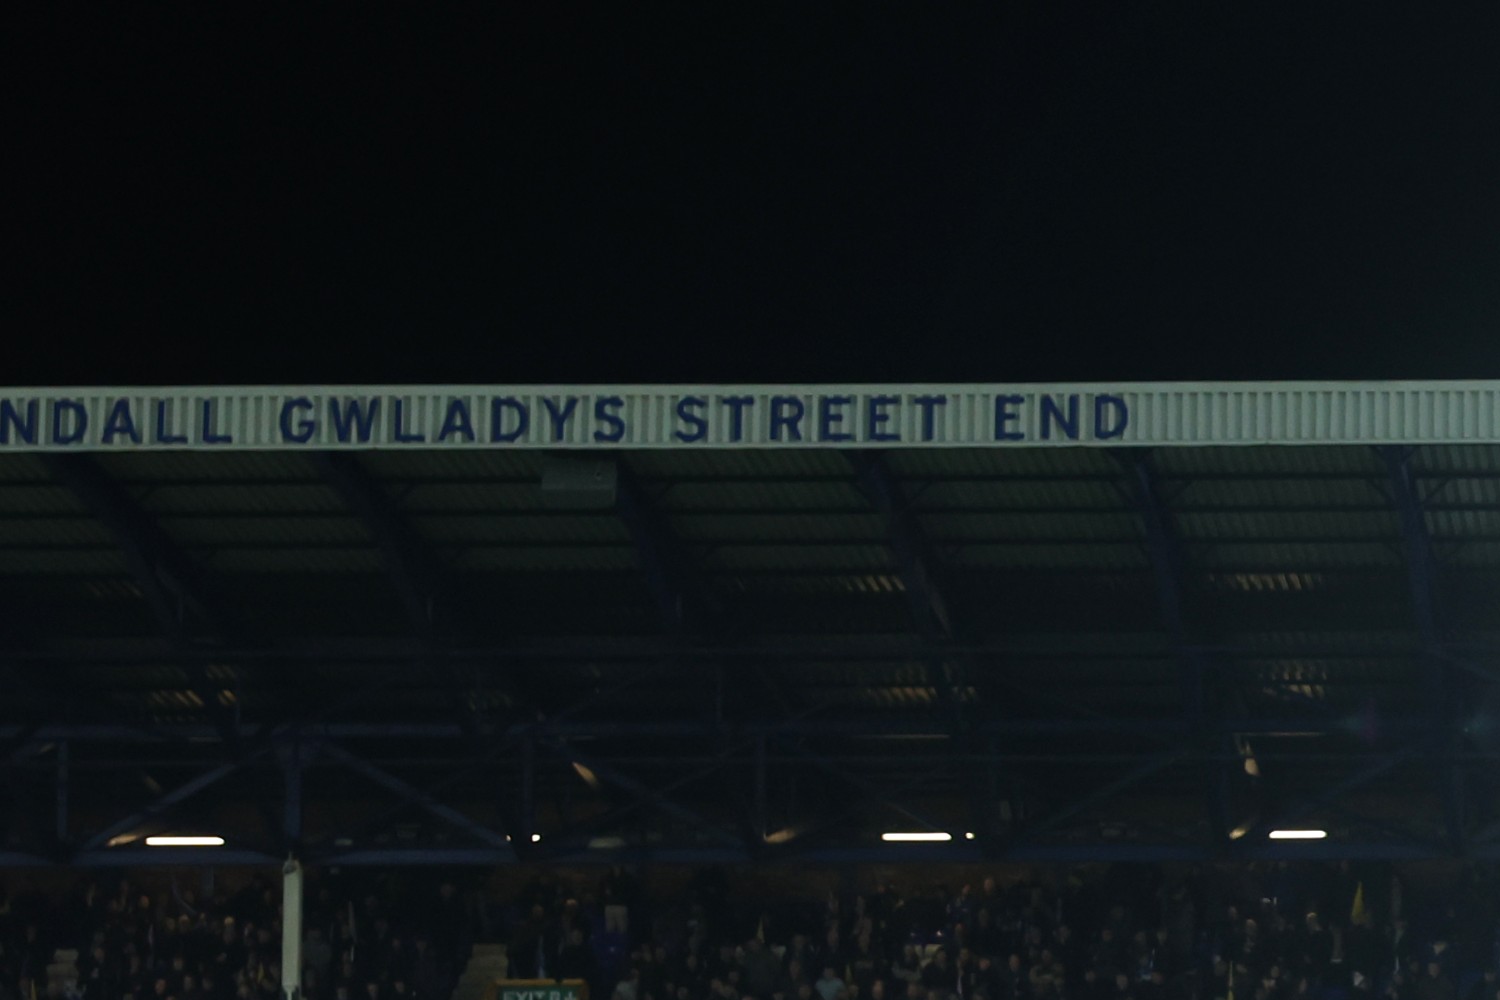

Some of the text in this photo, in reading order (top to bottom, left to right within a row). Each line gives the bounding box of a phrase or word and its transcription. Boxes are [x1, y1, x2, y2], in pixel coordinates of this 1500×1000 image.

[279, 396, 626, 444] GWLADYS
[674, 395, 949, 443] STREET
[993, 393, 1130, 441] END
